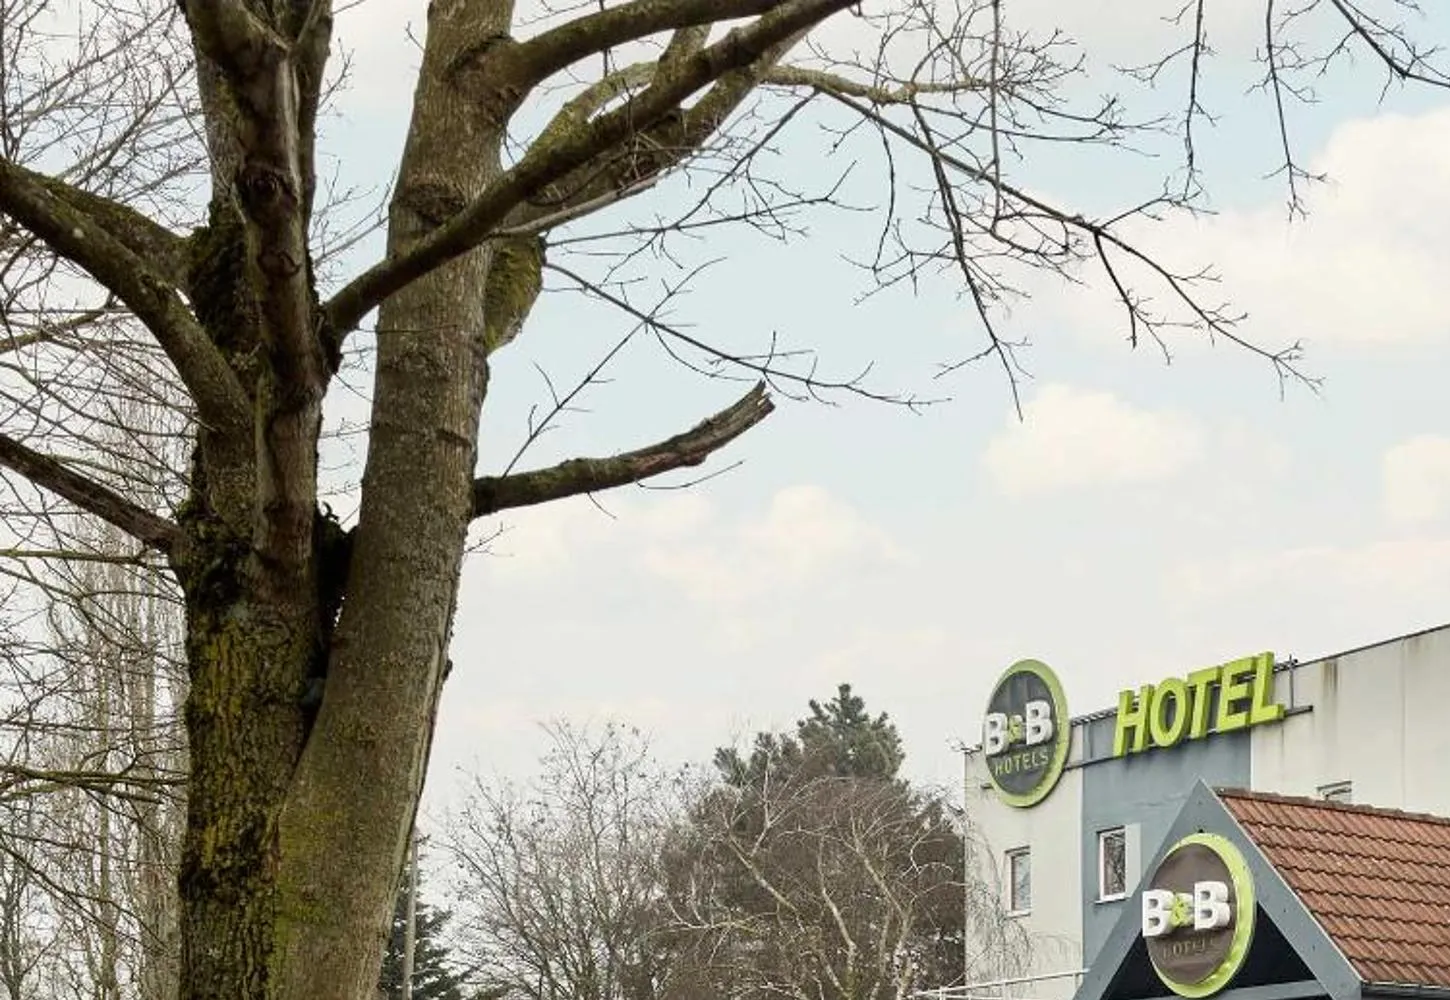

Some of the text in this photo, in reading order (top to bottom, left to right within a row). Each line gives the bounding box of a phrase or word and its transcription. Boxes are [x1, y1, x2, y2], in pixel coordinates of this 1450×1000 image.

[986, 700, 1052, 754] B&B
[1112, 651, 1286, 757] HOTEL
[994, 750, 1049, 777] HOTELS
[1142, 881, 1230, 937] B&B
